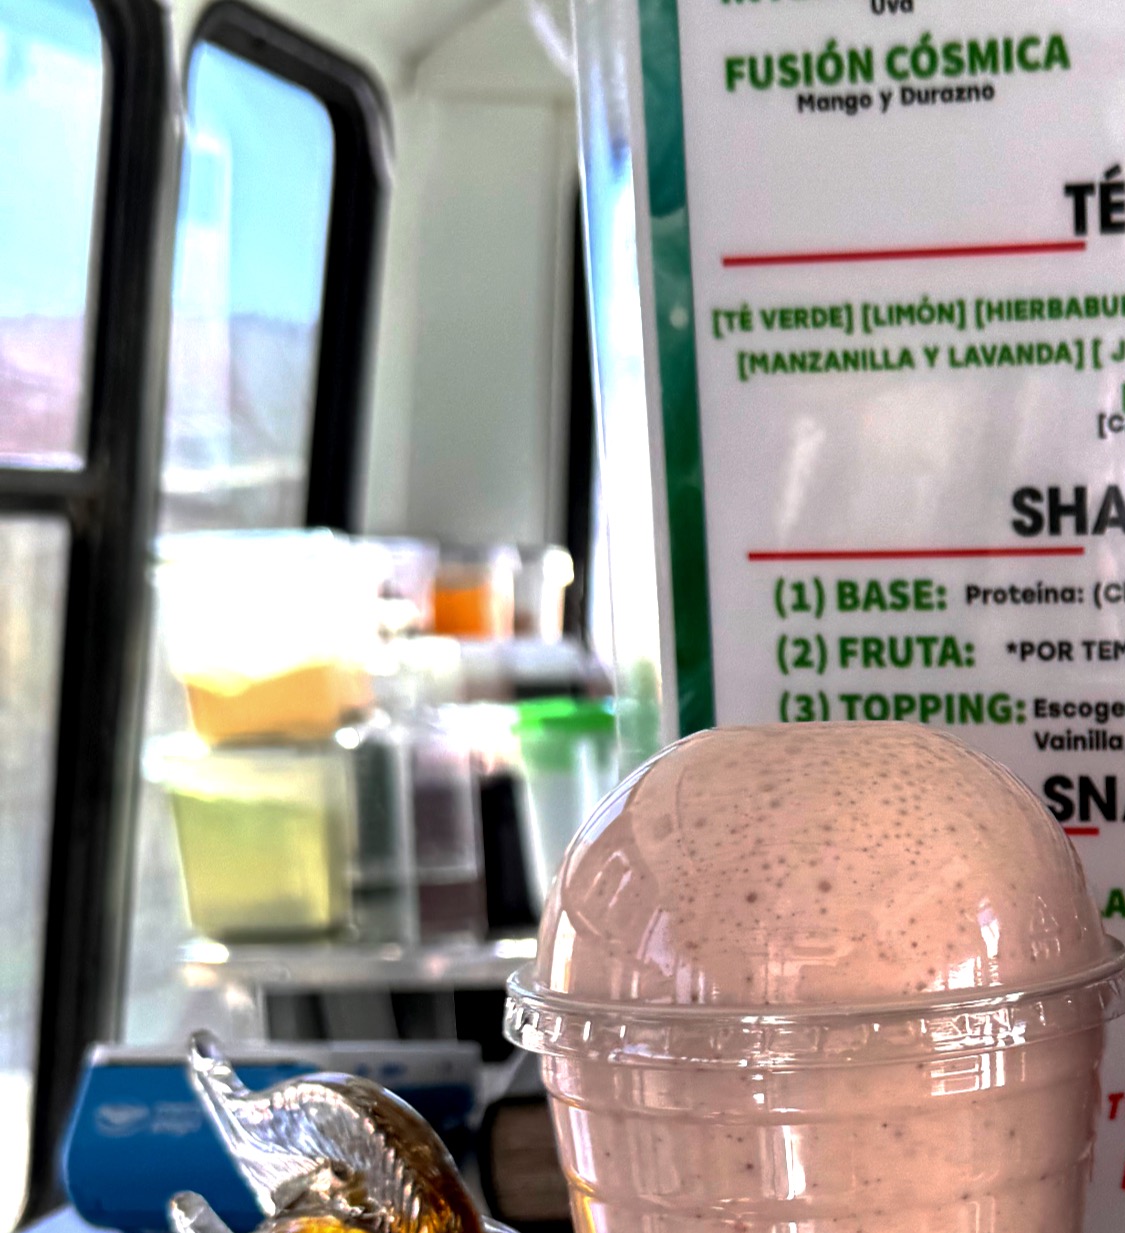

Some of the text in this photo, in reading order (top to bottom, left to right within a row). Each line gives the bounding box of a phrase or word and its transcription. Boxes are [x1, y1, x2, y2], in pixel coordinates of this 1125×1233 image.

[725, 30, 1071, 92] FUSIÓN CÓSMICA
[797, 81, 995, 116] Mango y Durazno
[711, 303, 754, 339] [TÉ
[760, 302, 854, 335] VERDE]
[861, 295, 967, 334] [LIMÓN]
[737, 345, 915, 382] [MANZANILLA
[922, 344, 940, 369] Y
[947, 338, 1085, 371] LAVANDA]
[774, 576, 826, 620] (1)
[836, 578, 948, 613] BASE:
[965, 580, 1085, 607] Proteína:
[776, 633, 828, 676] (2)
[838, 634, 976, 669] FRUTA:
[779, 690, 830, 723] (3)
[840, 691, 1027, 725] TOPPING:
